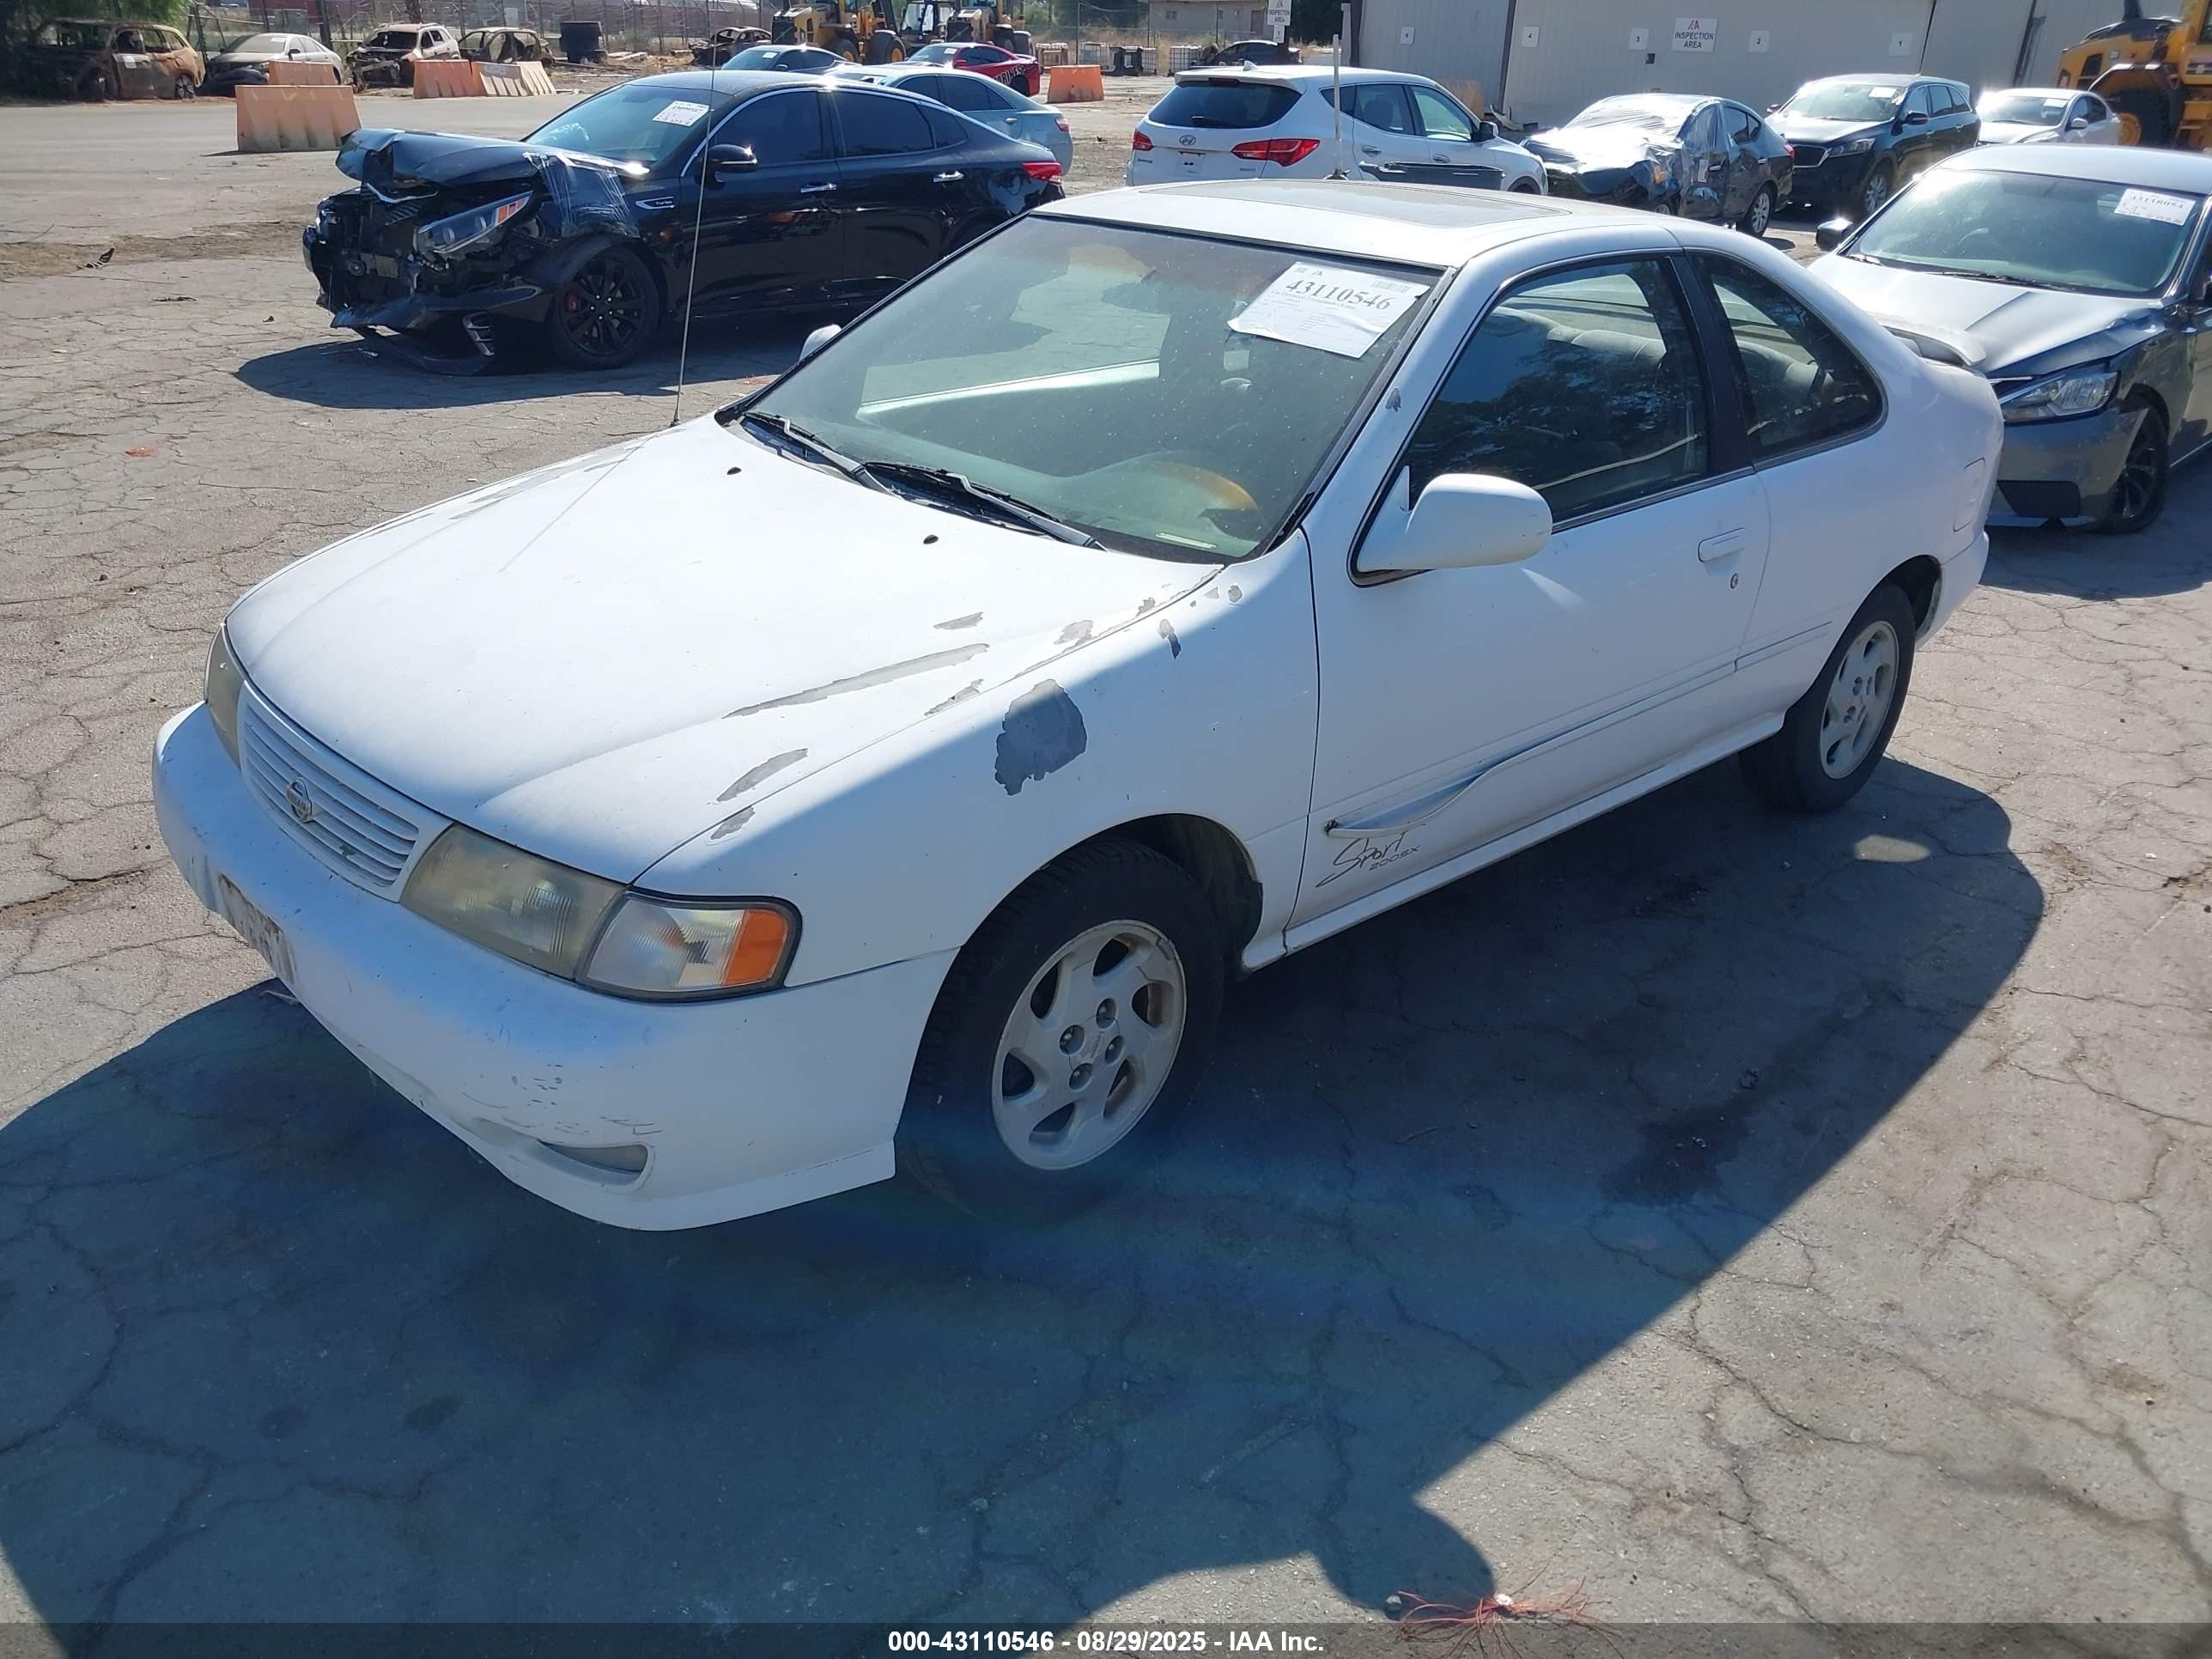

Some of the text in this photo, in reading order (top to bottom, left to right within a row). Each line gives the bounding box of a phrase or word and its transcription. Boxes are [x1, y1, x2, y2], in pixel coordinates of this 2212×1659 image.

[1674, 32, 1715, 40] INSPECTION
[1285, 279, 1396, 310] 43110546
[1315, 830, 1415, 888] Sport
[1369, 845, 1421, 872] 200SX
